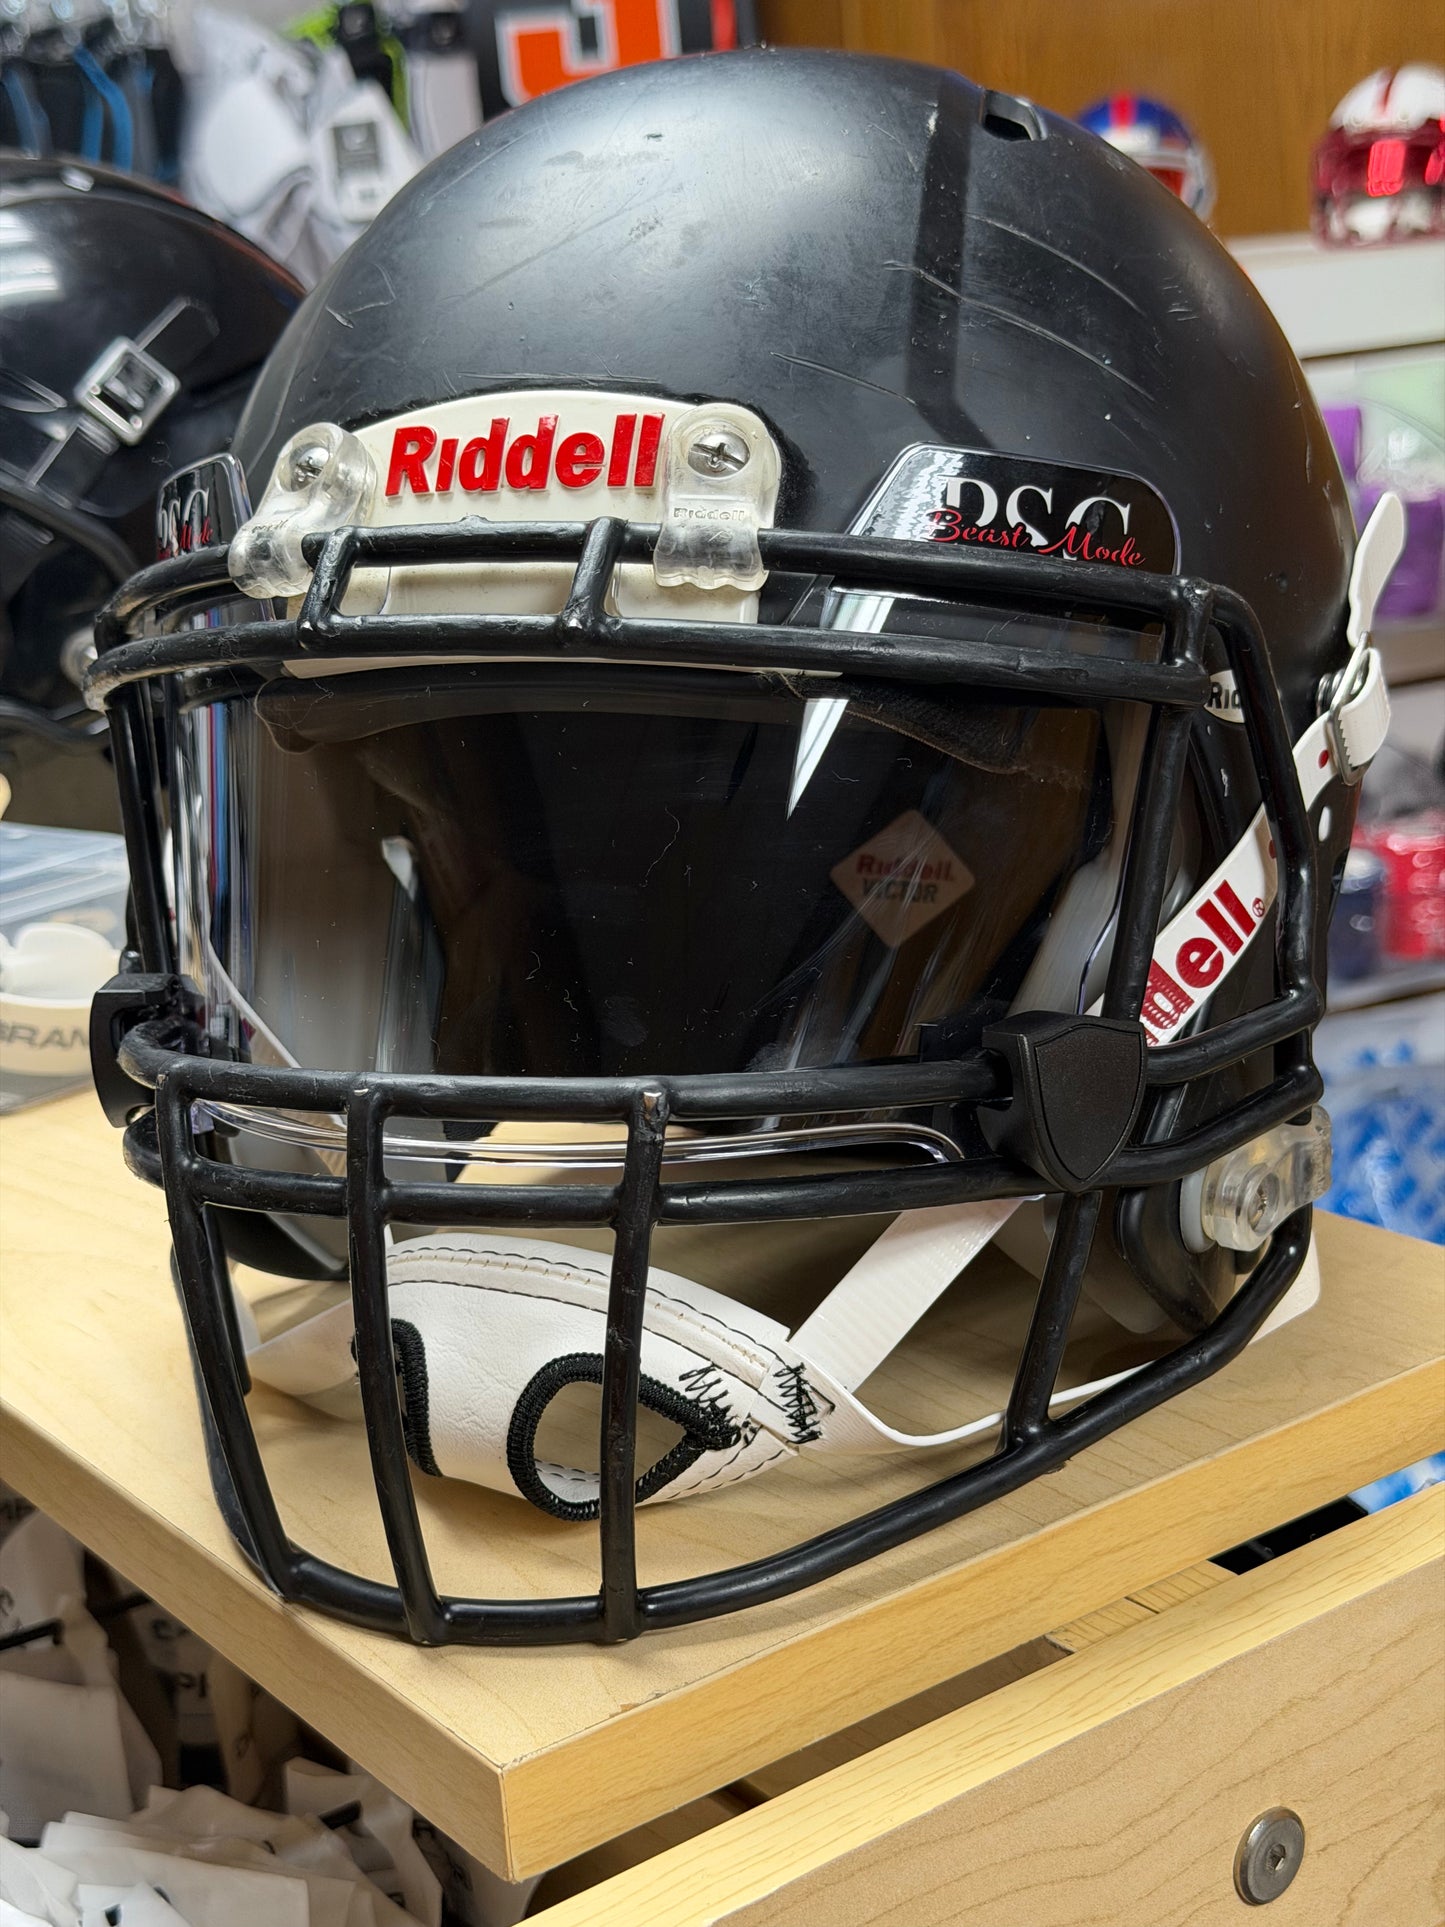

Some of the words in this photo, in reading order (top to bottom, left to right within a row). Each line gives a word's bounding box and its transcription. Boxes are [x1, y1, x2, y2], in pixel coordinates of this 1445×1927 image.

[385, 413, 666, 497] Riddell
[926, 508, 1028, 548] Beast
[936, 476, 1131, 560] DSC
[1038, 525, 1146, 566] Mode
[1140, 879, 1258, 1044] dell
